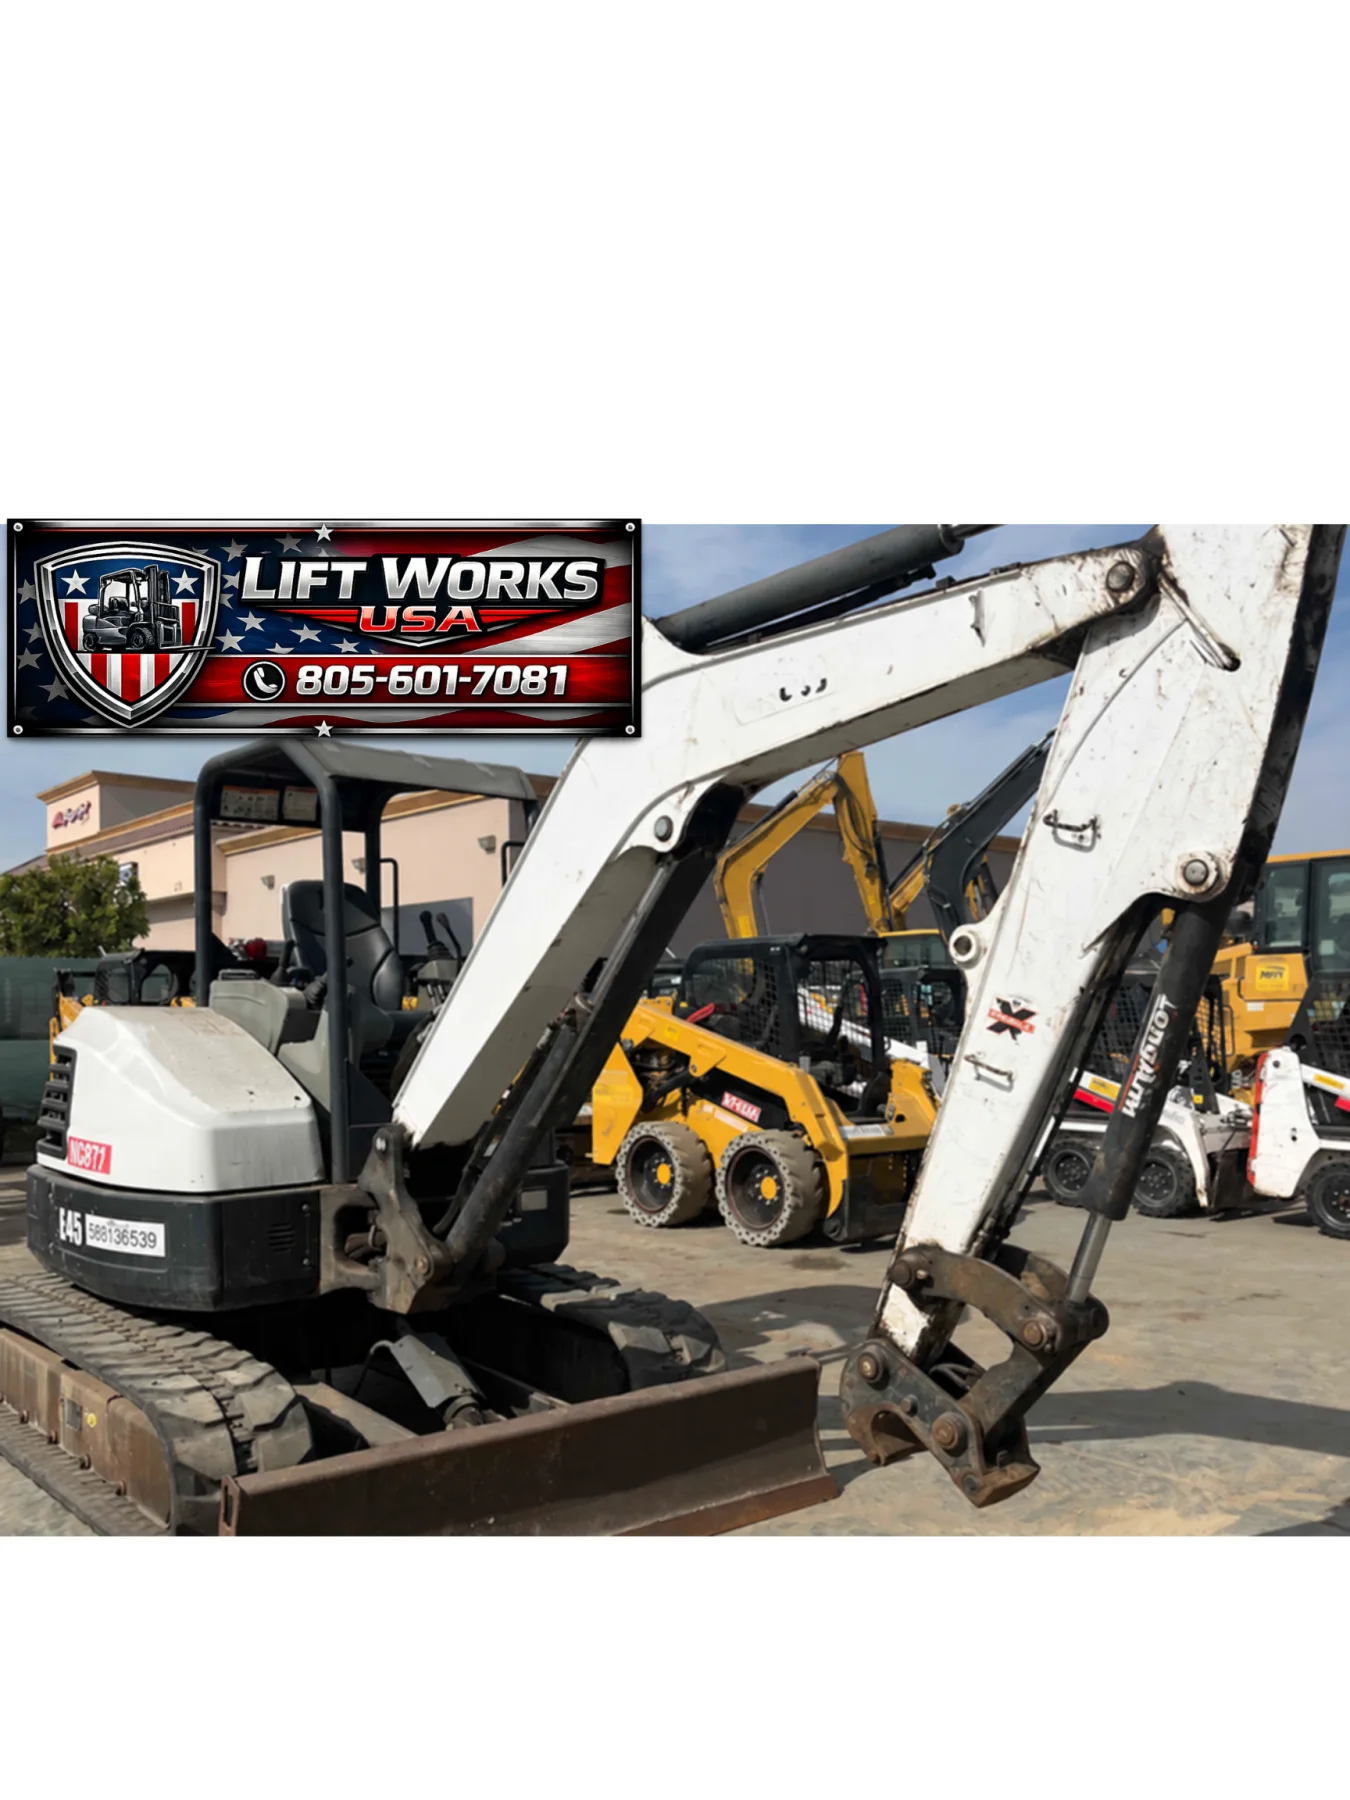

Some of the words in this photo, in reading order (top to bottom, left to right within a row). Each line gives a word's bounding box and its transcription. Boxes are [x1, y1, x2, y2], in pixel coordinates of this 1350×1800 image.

[69, 1139, 106, 1171] NC871
[59, 1207, 83, 1247] E45
[88, 1222, 158, 1249] 588136539
